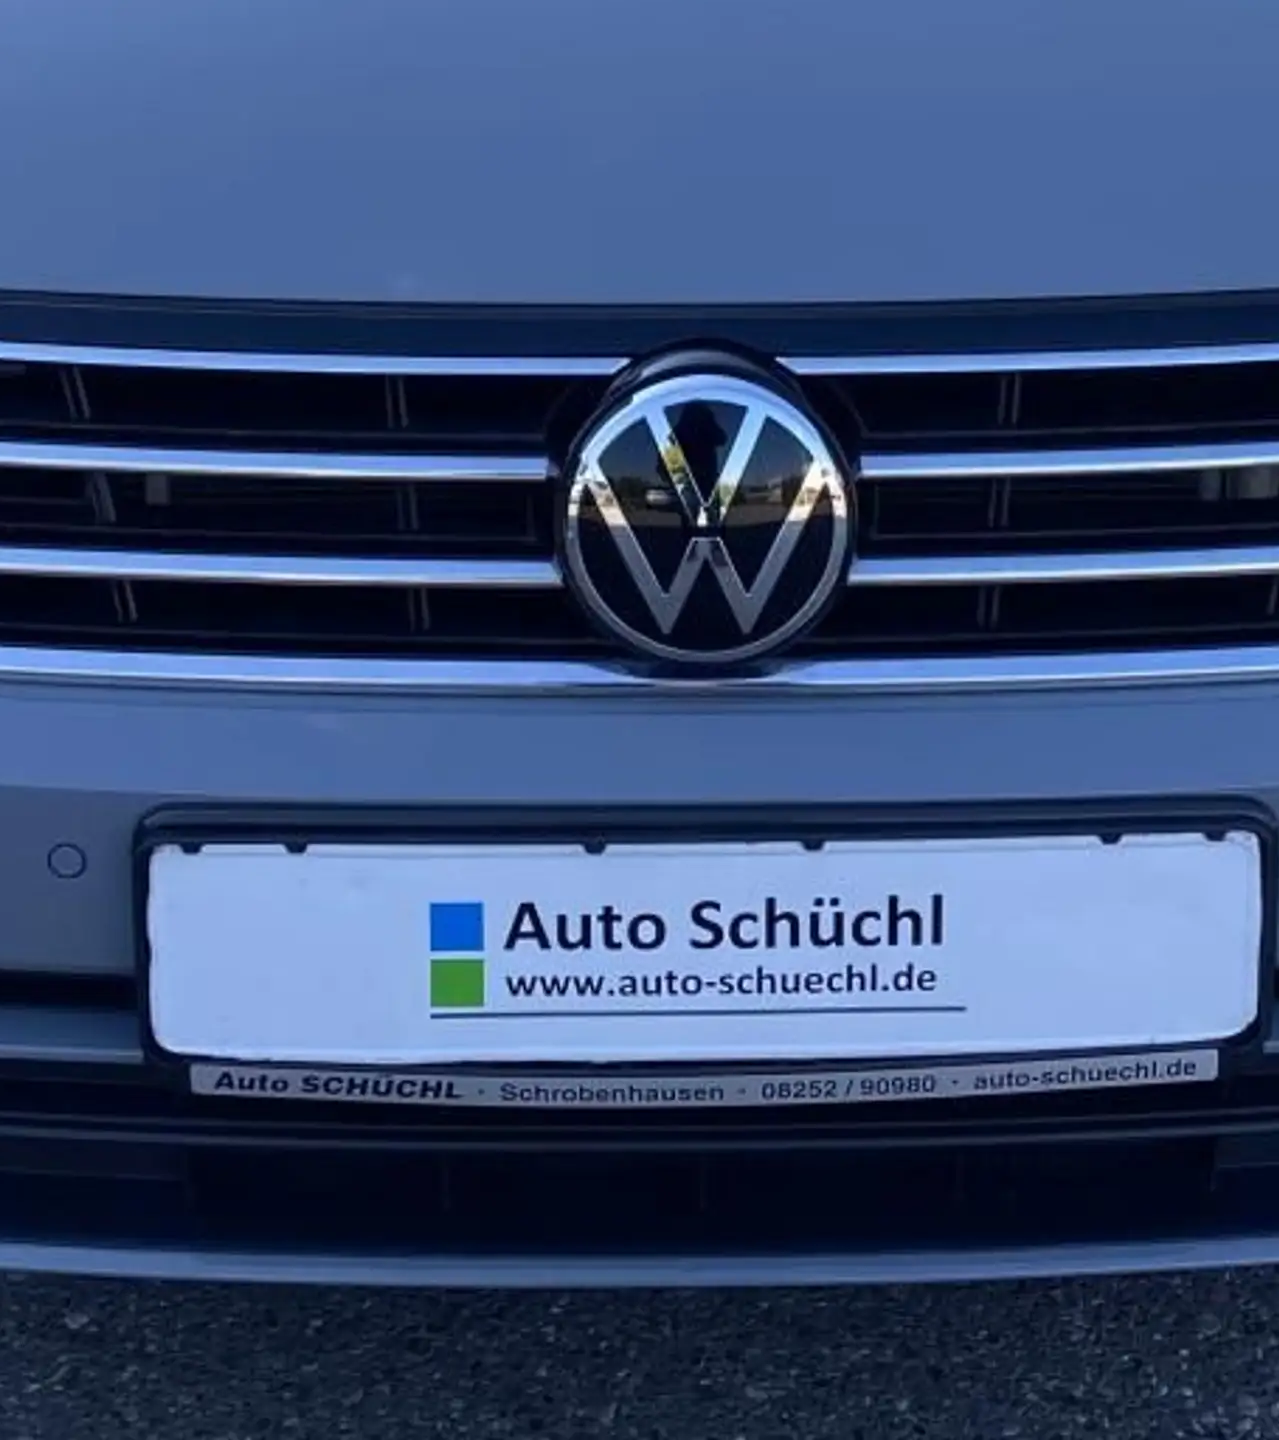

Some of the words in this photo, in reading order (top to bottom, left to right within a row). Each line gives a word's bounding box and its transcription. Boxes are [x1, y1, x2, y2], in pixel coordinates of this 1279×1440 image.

[504, 902, 666, 951] Auto
[689, 893, 943, 949] Schüchl
[505, 962, 937, 997] www.auto-schuechl.de
[214, 1071, 289, 1093] Auto
[301, 1073, 464, 1100] SCHÜCHL
[499, 1082, 725, 1103] Schrobenhausen
[972, 1057, 1198, 1091] auto-schuechl.de
